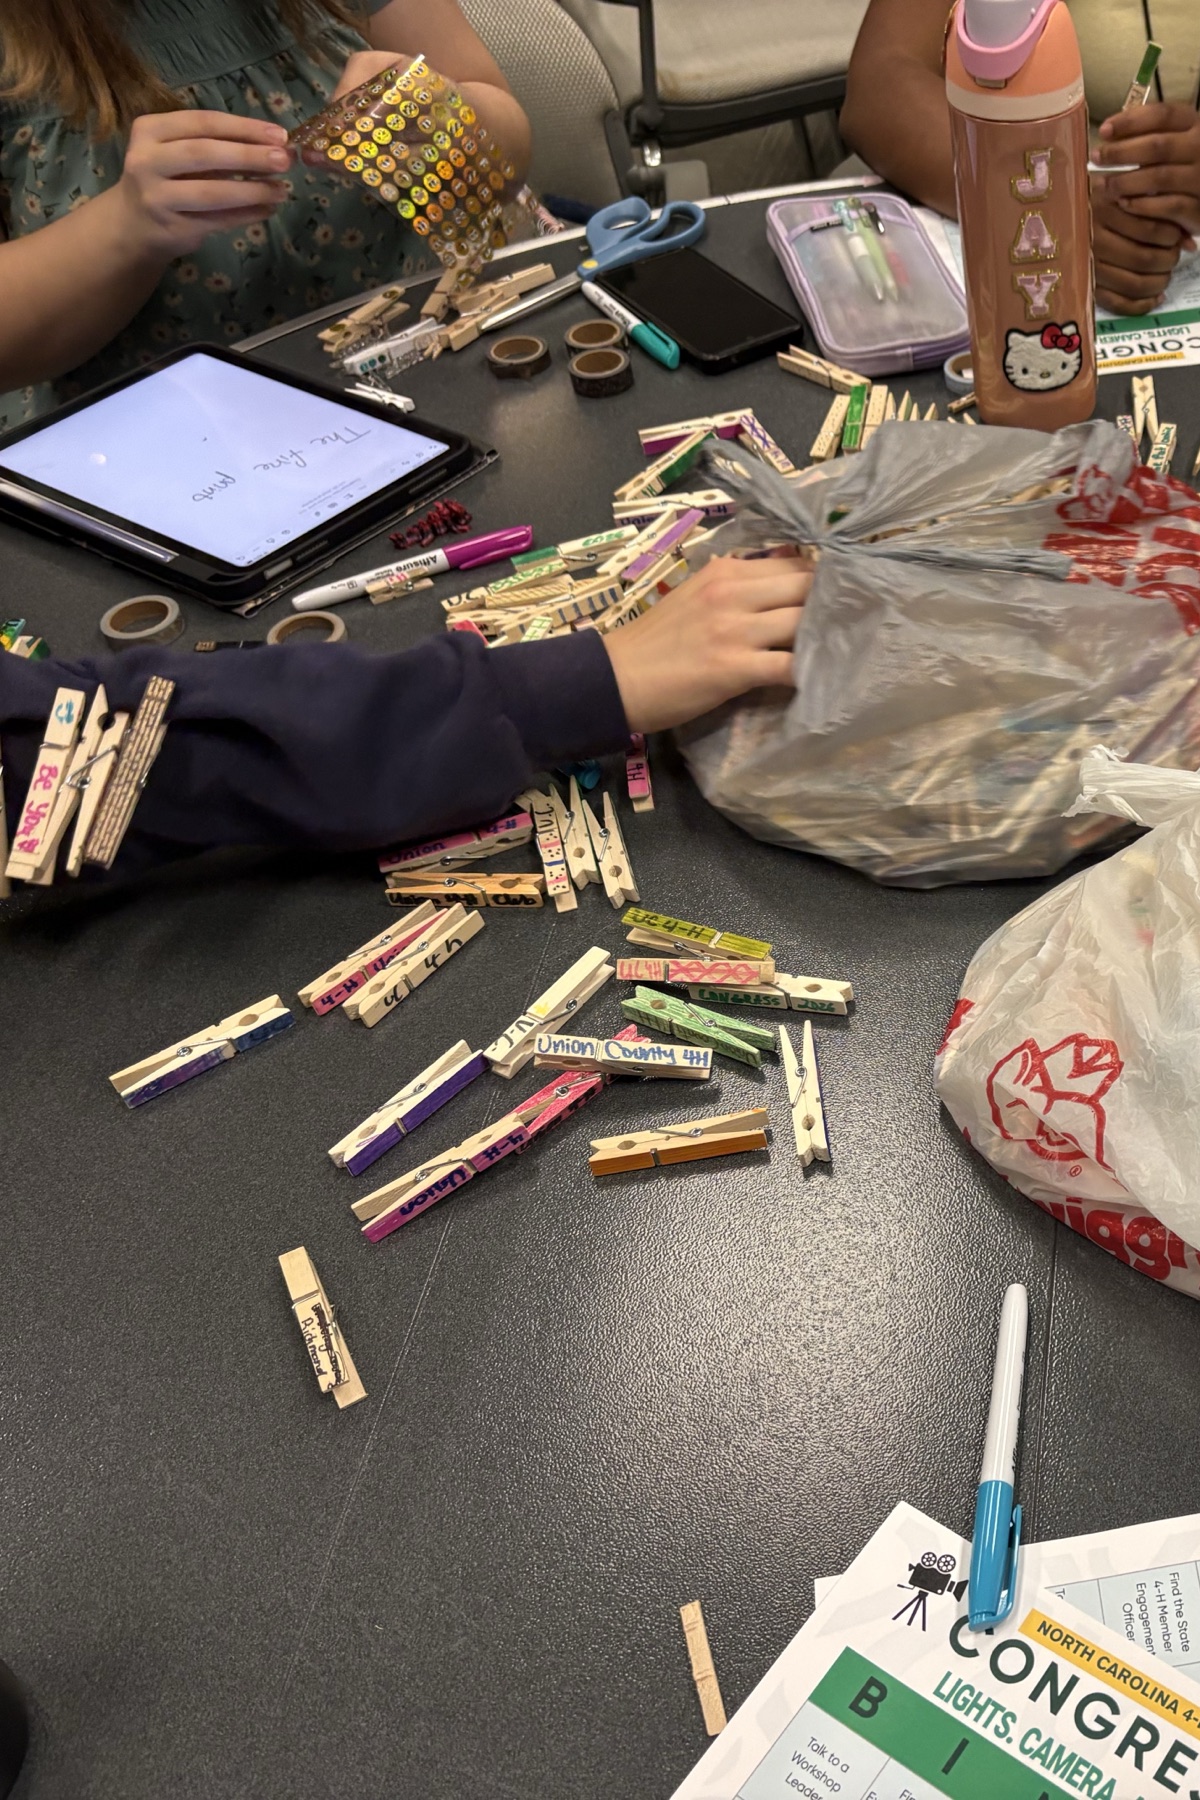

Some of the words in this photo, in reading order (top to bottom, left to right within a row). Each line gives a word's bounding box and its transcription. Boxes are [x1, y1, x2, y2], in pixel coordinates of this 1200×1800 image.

[1009, 147, 1062, 321] JAY
[537, 1035, 595, 1058] Union
[604, 1040, 677, 1066] County
[682, 1048, 711, 1068] 4H
[1037, 1620, 1095, 1662] NORTH
[1096, 1656, 1179, 1714] CAROLINA
[933, 1671, 1017, 1744] LIGHTS.
[791, 1751, 841, 1793] Workshop
[807, 1736, 828, 1758] Talk
[827, 1753, 840, 1767] to
[840, 1763, 850, 1773] a
